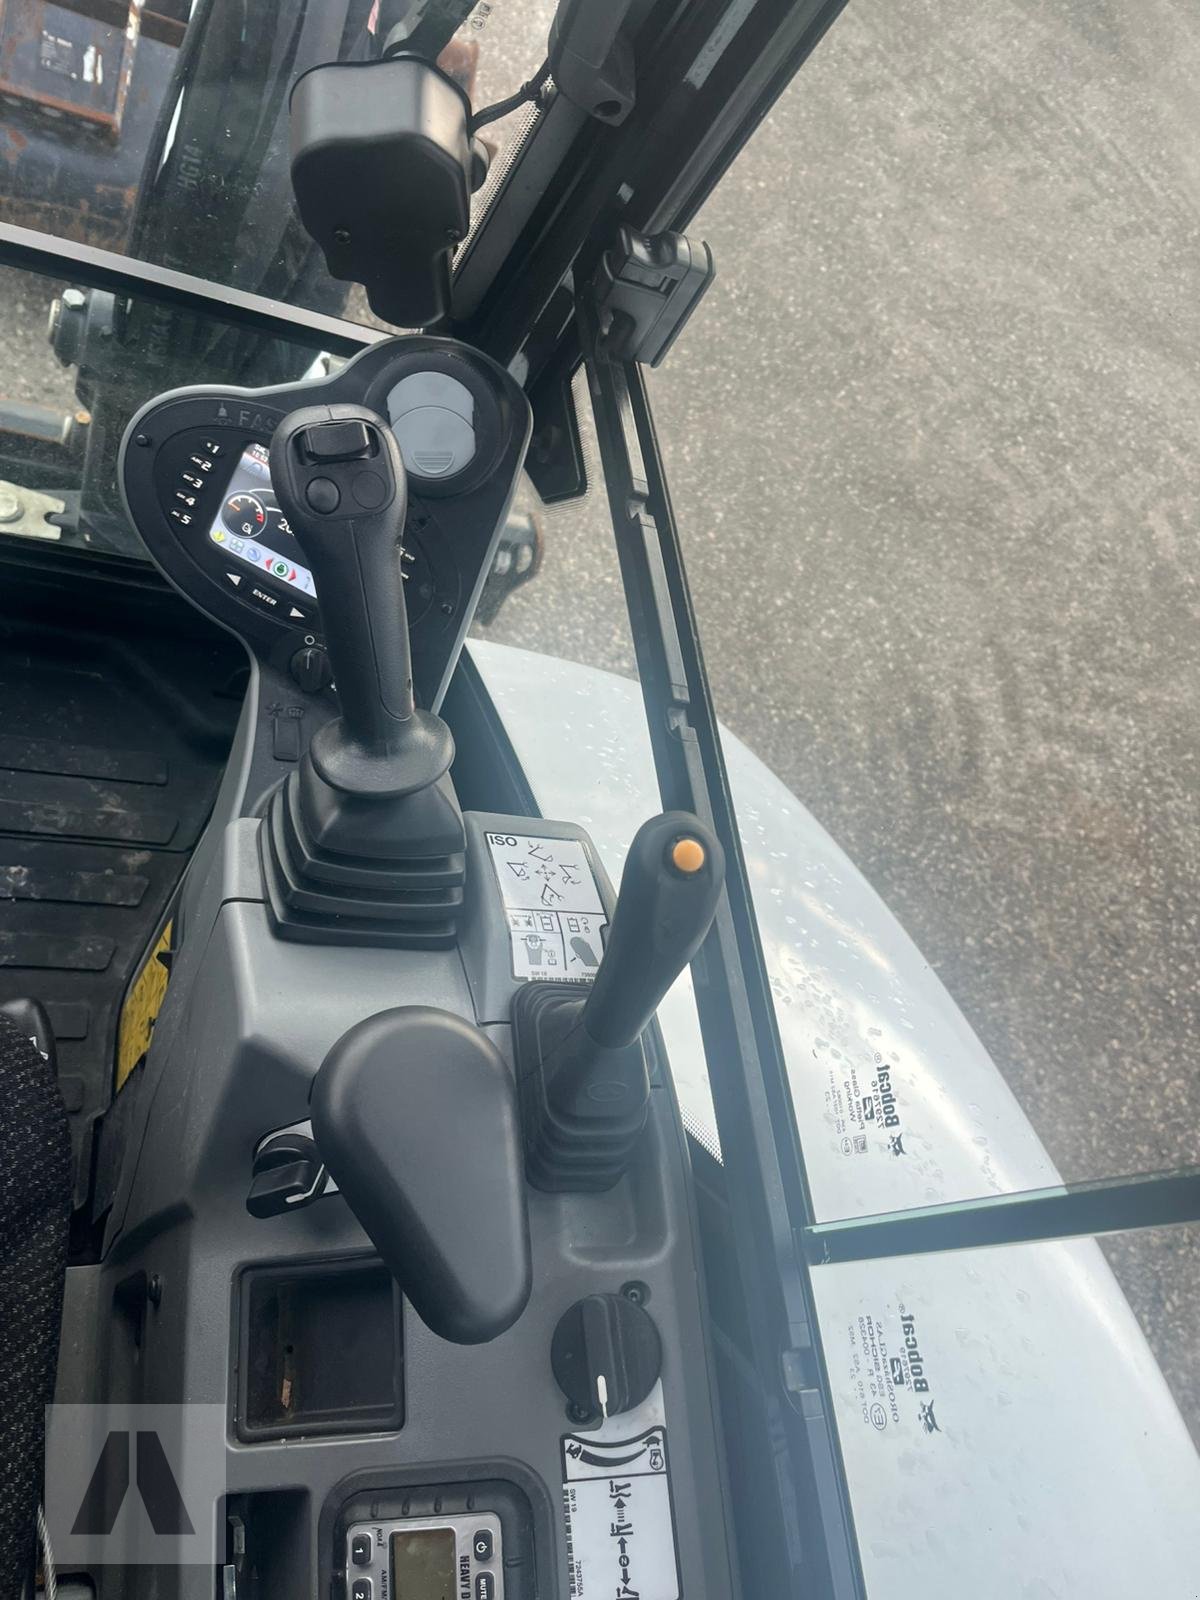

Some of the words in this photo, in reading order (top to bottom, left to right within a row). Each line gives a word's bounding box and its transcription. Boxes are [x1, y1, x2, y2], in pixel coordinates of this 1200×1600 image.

[239, 410, 279, 430] FAS
[201, 461, 212, 472] 2
[193, 479, 203, 489] 3
[185, 497, 196, 506] 4
[181, 514, 191, 525] 5
[252, 588, 278, 606] ENTER
[489, 835, 518, 847] ISO
[459, 1555, 470, 1590] HEAVY
[461, 1592, 471, 1600] D
